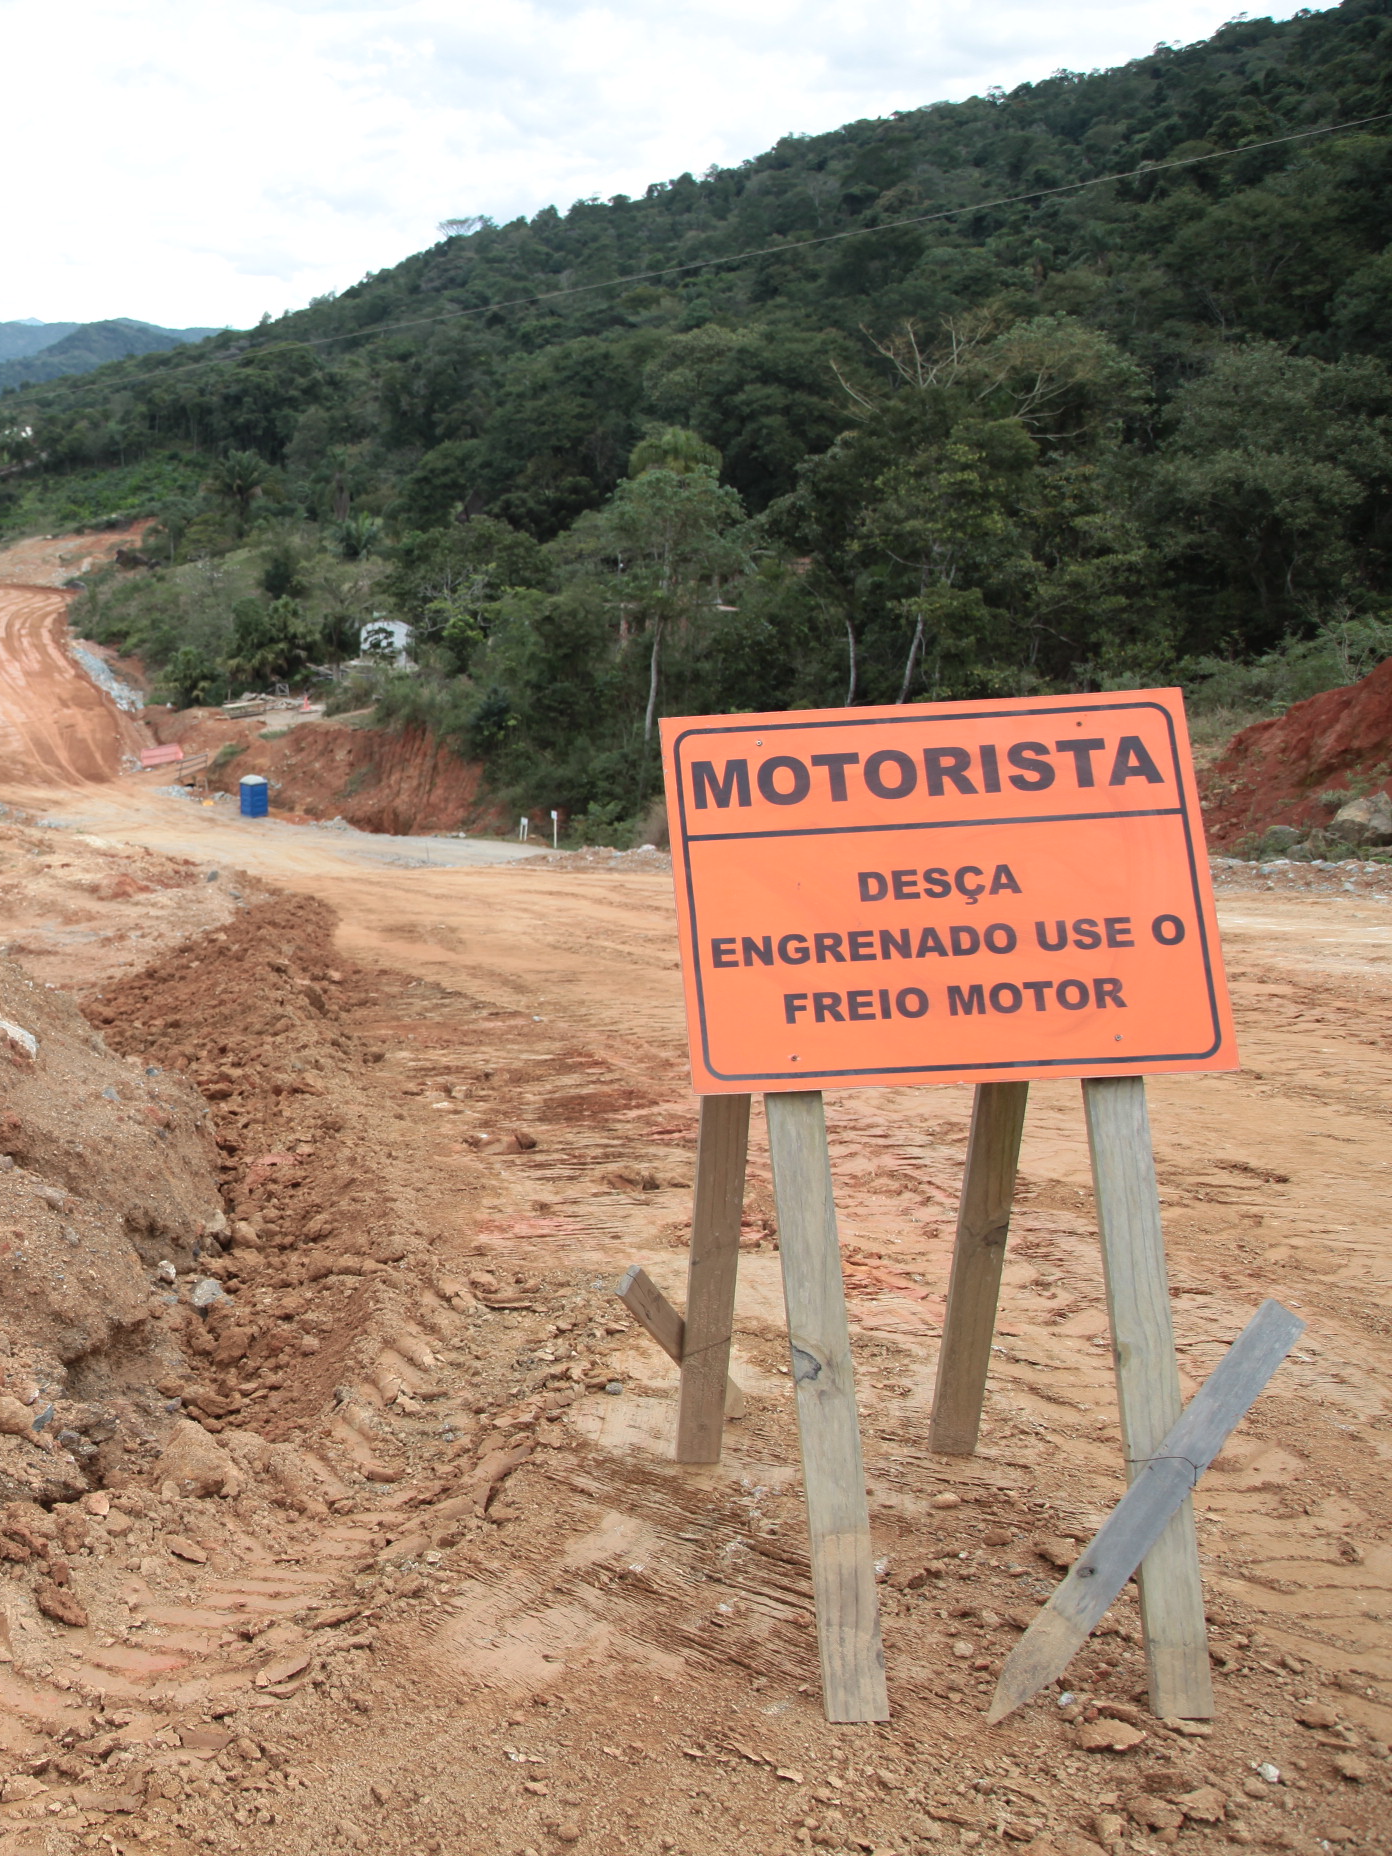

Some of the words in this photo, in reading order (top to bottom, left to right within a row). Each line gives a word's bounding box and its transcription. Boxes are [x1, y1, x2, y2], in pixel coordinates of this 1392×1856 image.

[691, 735, 1164, 810] MOTORISTA
[858, 863, 1022, 905] DESÇA
[711, 922, 1018, 968] ENGRENADO
[1035, 916, 1135, 952] USE
[1151, 914, 1186, 946] O
[783, 986, 930, 1025] FREIO
[946, 977, 1128, 1016] MOTOR
